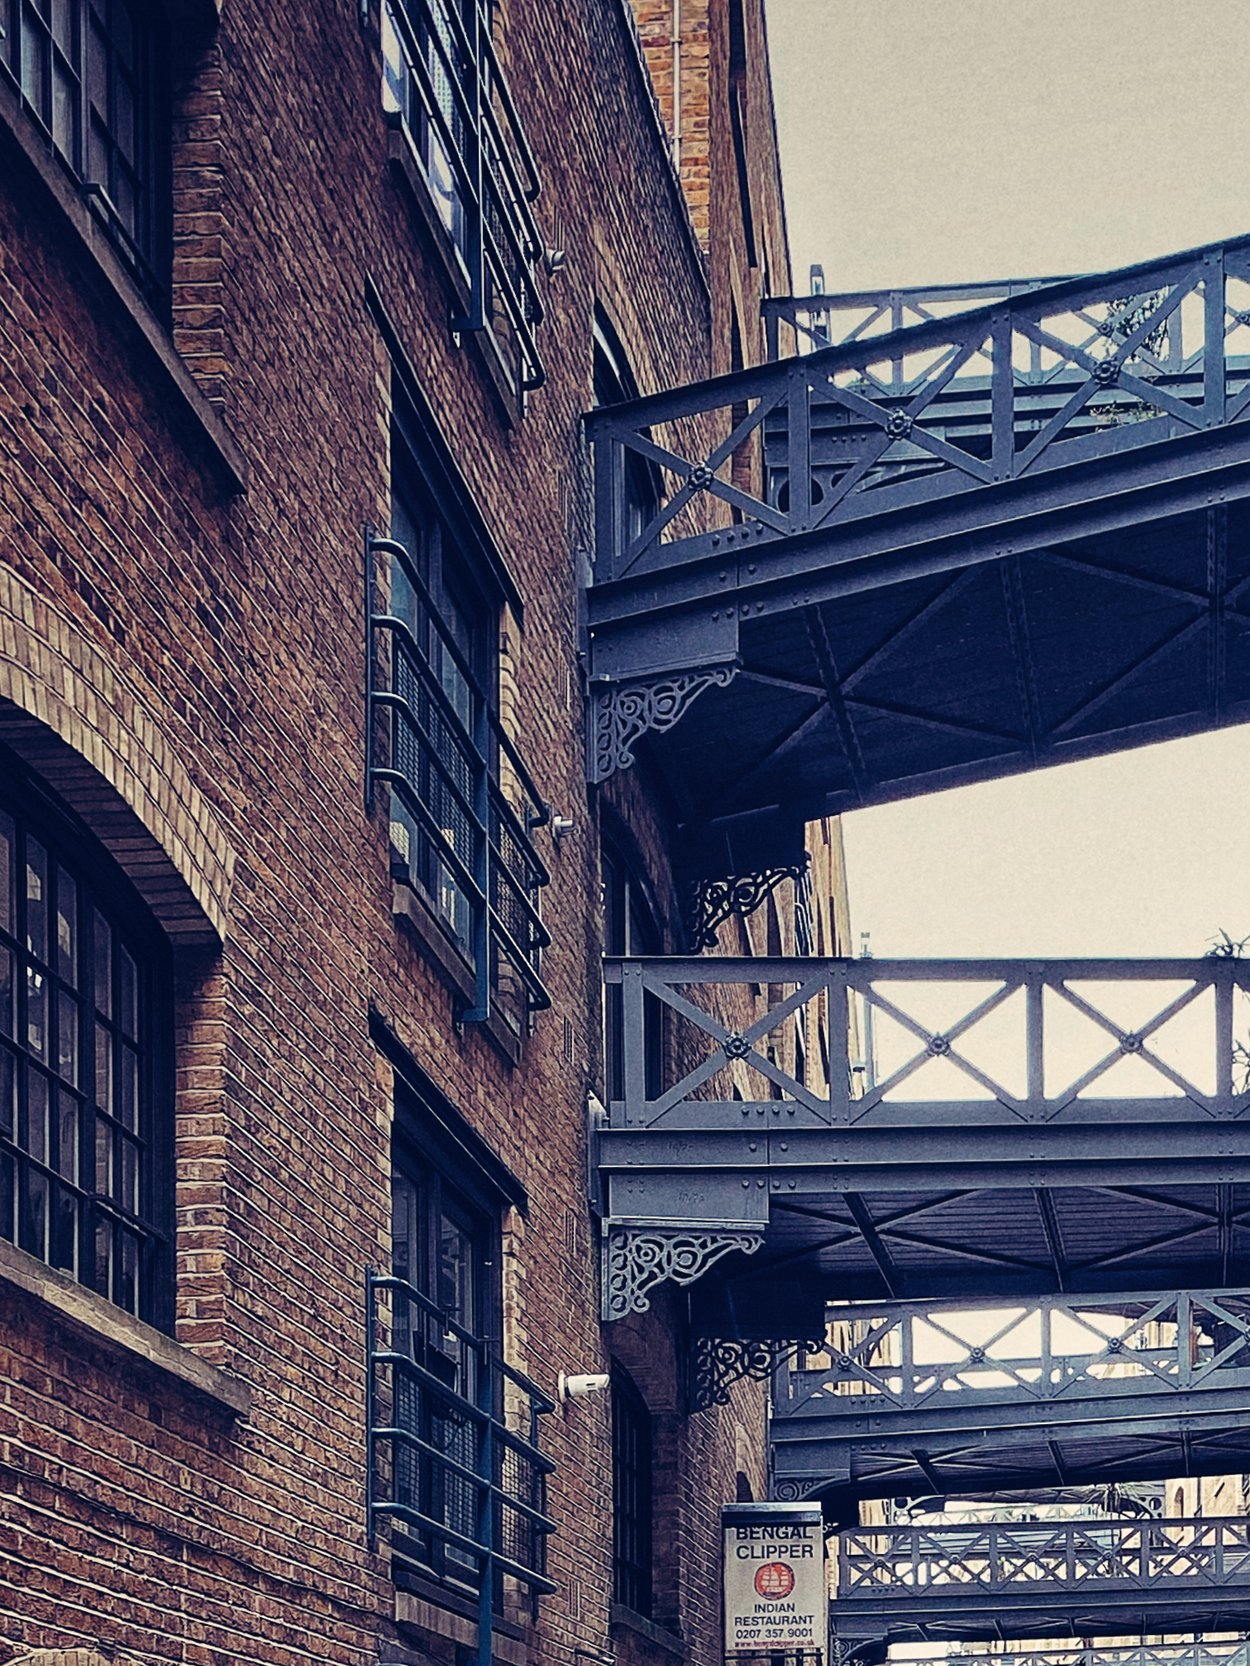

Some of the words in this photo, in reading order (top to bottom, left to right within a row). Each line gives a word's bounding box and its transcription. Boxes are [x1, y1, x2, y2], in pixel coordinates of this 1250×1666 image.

[736, 1526, 814, 1540] BENGAL
[736, 1544, 814, 1559] CLIPPER
[754, 1603, 796, 1613] INDIAN
[734, 1615, 815, 1626] RESTAURANT
[736, 1629, 761, 1639] 0207
[765, 1629, 784, 1638] 357
[787, 1628, 813, 1638] 9001
